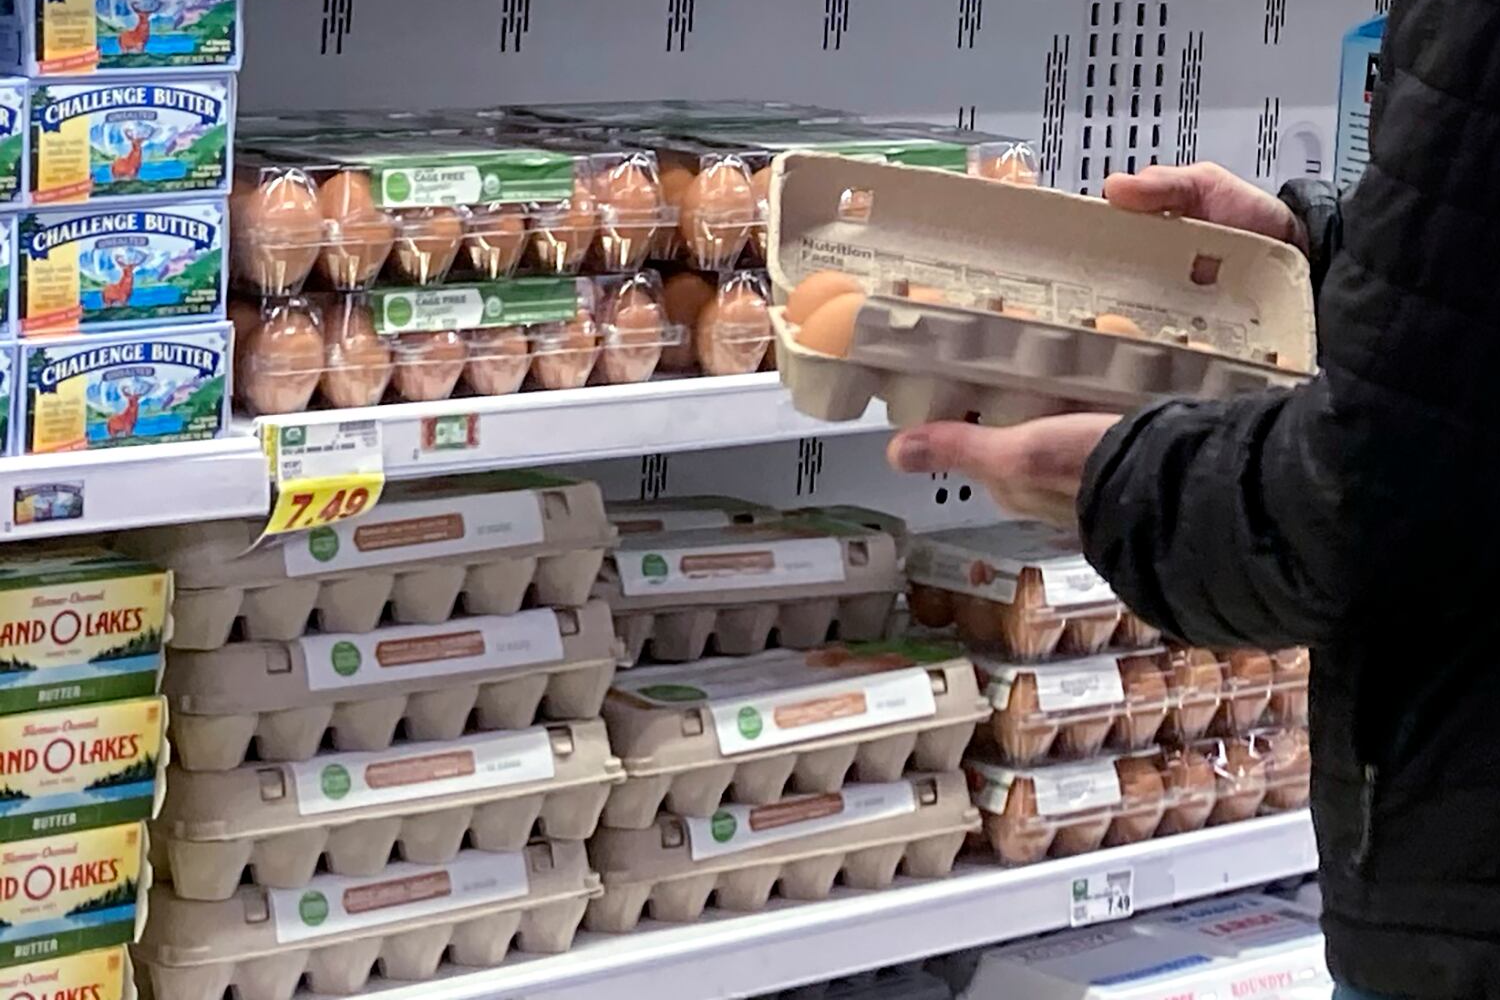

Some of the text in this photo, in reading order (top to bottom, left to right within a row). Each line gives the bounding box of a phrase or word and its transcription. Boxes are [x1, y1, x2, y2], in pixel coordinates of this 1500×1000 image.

[45, 86, 217, 124] CHALLENGE BUTTER
[440, 171, 466, 182] FREE
[33, 213, 209, 252] CHALLENGE BUTTER
[801, 249, 845, 268] Facts
[802, 237, 872, 260] Nutrition
[42, 343, 214, 386] CHALLENGE BUTTER
[284, 487, 370, 530] 7.49
[84, 606, 144, 638] LAKES
[38, 684, 82, 703] BUTTER
[79, 733, 139, 766] LAKES
[33, 811, 77, 832] BUTTER
[60, 858, 119, 892] LAKES
[1107, 895, 1131, 915] 7.49
[14, 938, 59, 959] BUTTER
